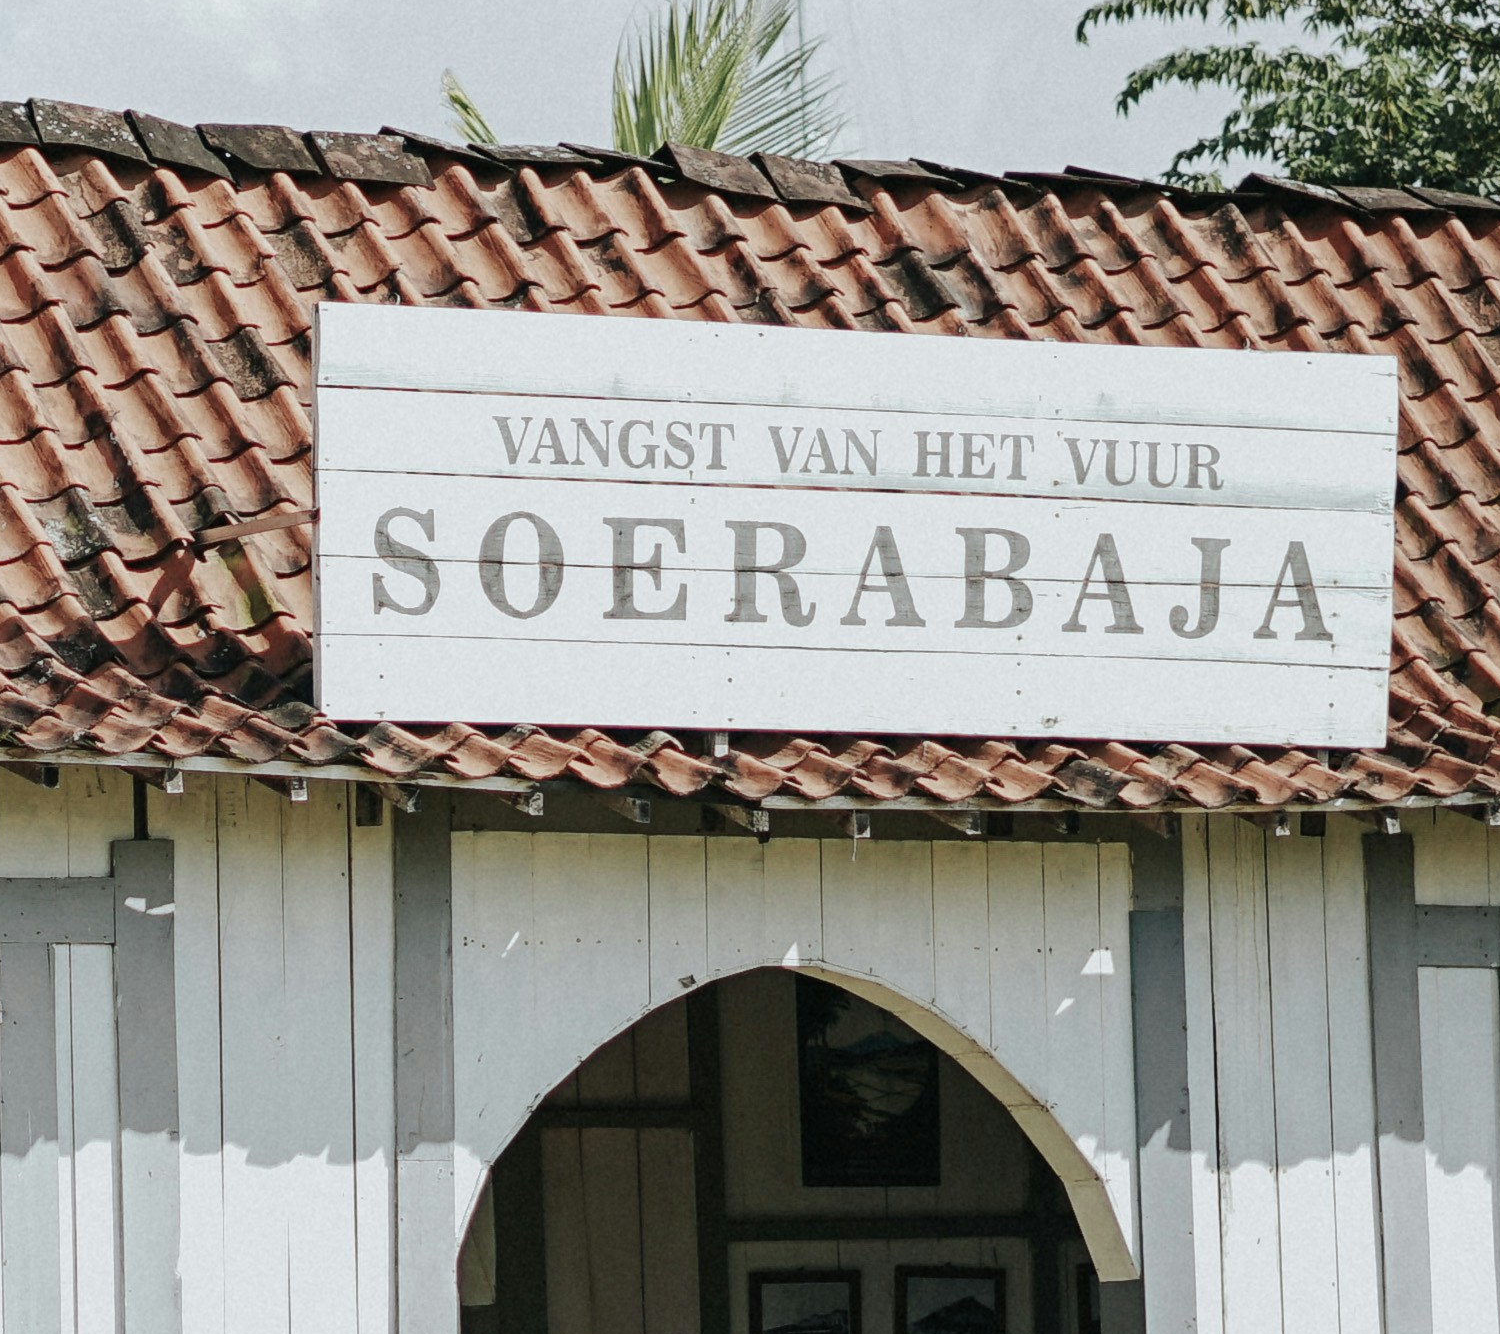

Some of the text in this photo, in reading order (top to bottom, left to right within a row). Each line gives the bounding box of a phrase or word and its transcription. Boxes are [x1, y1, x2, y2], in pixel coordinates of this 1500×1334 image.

[492, 415, 1225, 492] VANGST VAN HET VUUR
[372, 506, 1334, 642] SOERABAJA
